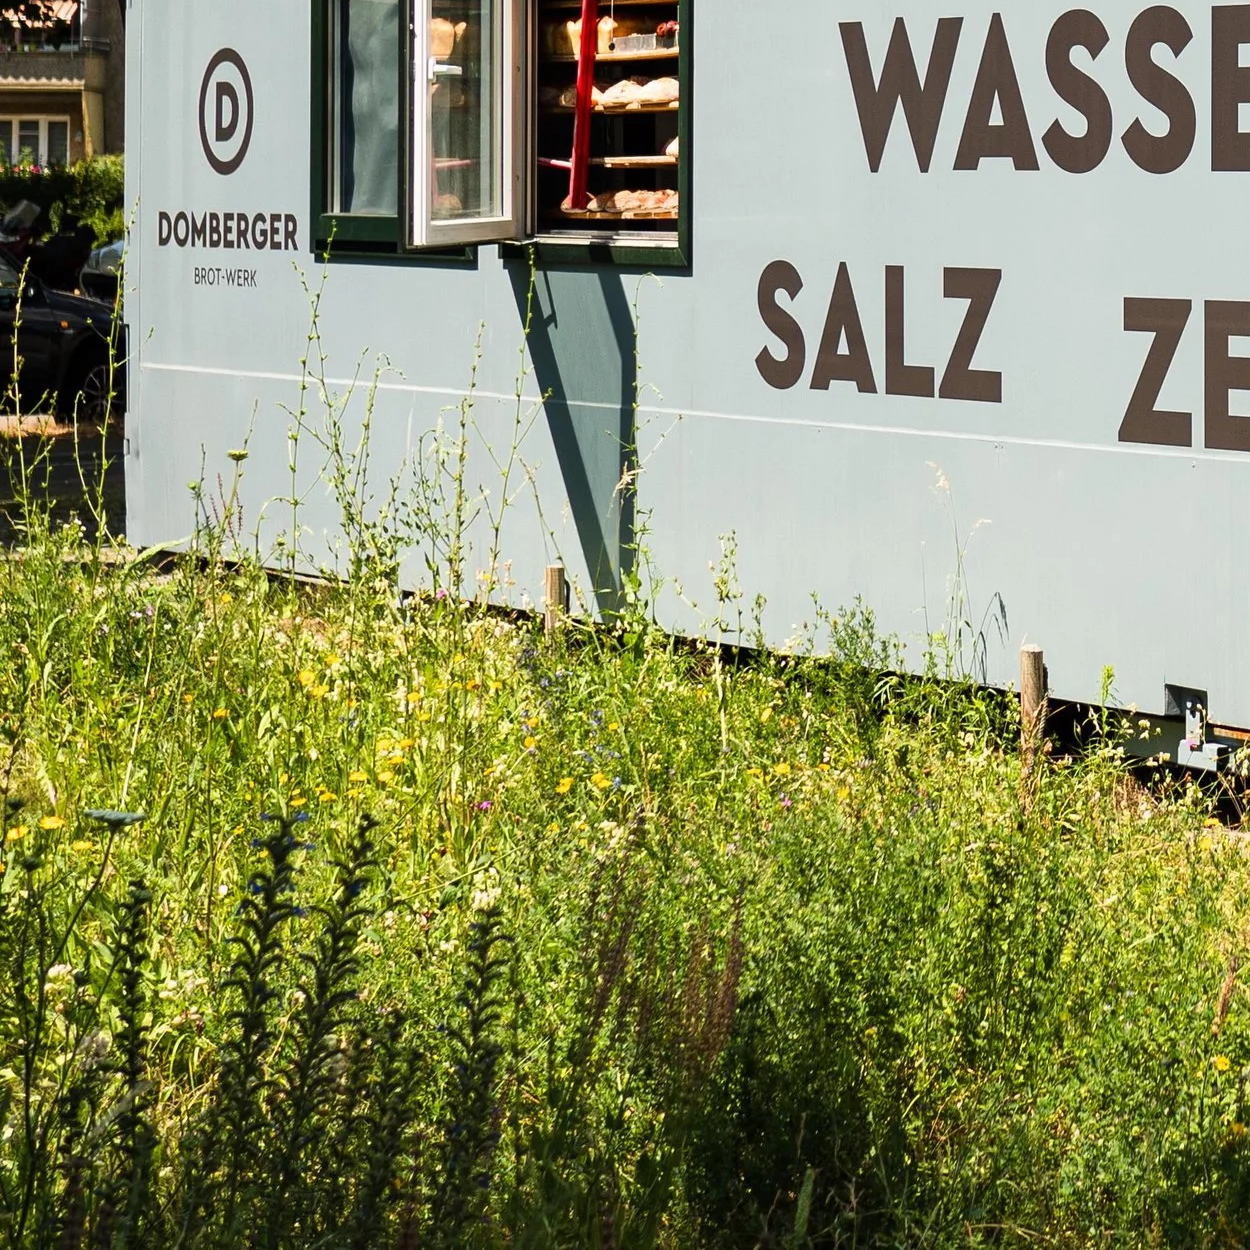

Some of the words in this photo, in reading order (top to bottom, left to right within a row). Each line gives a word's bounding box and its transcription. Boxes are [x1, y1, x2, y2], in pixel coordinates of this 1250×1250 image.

[215, 81, 239, 141] D
[158, 211, 298, 251] DOMBERGER
[194, 266, 257, 288] BROT-WERK
[755, 260, 1002, 402] SALZ
